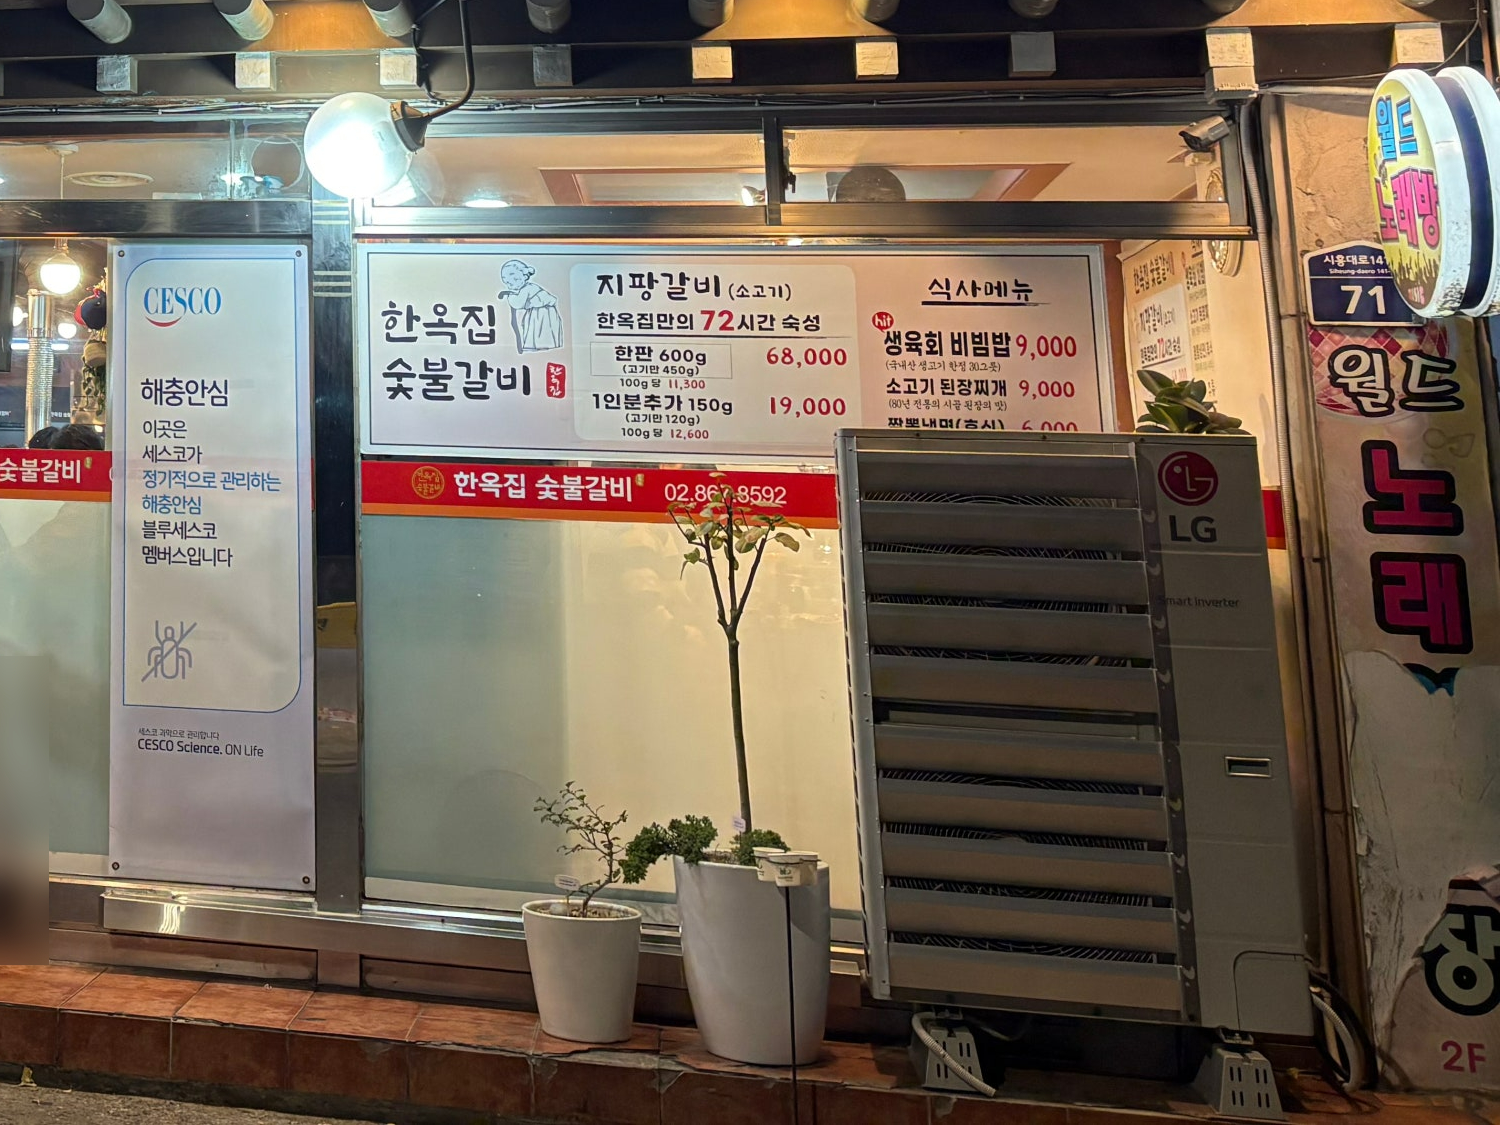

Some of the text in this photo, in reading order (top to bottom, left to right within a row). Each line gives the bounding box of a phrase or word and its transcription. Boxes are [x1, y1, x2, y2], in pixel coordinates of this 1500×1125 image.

[1376, 95, 1419, 162] 월드
[1375, 166, 1440, 249] 노래방
[596, 272, 792, 301] 지팡갈비 (소고기)
[927, 278, 1034, 301] 식사메뉴
[143, 286, 222, 316] CESCO
[1341, 286, 1385, 314] 71
[380, 301, 496, 346] 한옥집
[596, 309, 821, 333] 한옥집만의 72시간 숙성
[875, 315, 892, 327] hit
[614, 345, 848, 368] 한판 600g 68,000
[884, 330, 1077, 360] 생육회 비빔밥 9,000
[622, 365, 699, 377] (고기만 450g)
[919, 361, 946, 371] 생고기
[381, 357, 531, 401] 숯불갈비
[620, 378, 706, 390] 100g 당 11,300
[886, 378, 1075, 399] 소고기 된장찌개 9,000
[1328, 344, 1464, 417] 월드
[141, 377, 229, 407] 해충안심
[592, 393, 846, 418] 1인분추가 150g 19,000
[888, 399, 910, 409] (80년
[995, 401, 1007, 411] 맛)
[142, 420, 187, 439] 이곳은
[625, 413, 700, 426] (고기만 120g)
[621, 427, 709, 440] 100g 당 12,600
[142, 445, 202, 464] 세스코가
[142, 470, 281, 492] 정기적으로 관리하는
[453, 471, 526, 499] 한옥집
[534, 474, 632, 502] 숯불갈비
[142, 495, 201, 515] 해충안심
[142, 520, 217, 540] 블루세스코
[1169, 515, 1217, 543] LG
[142, 546, 232, 567] 멤버스입니다
[1158, 595, 1192, 607] Smart
[138, 738, 264, 757] CESCO Science. ON Life
[1440, 1040, 1486, 1073] 2F
